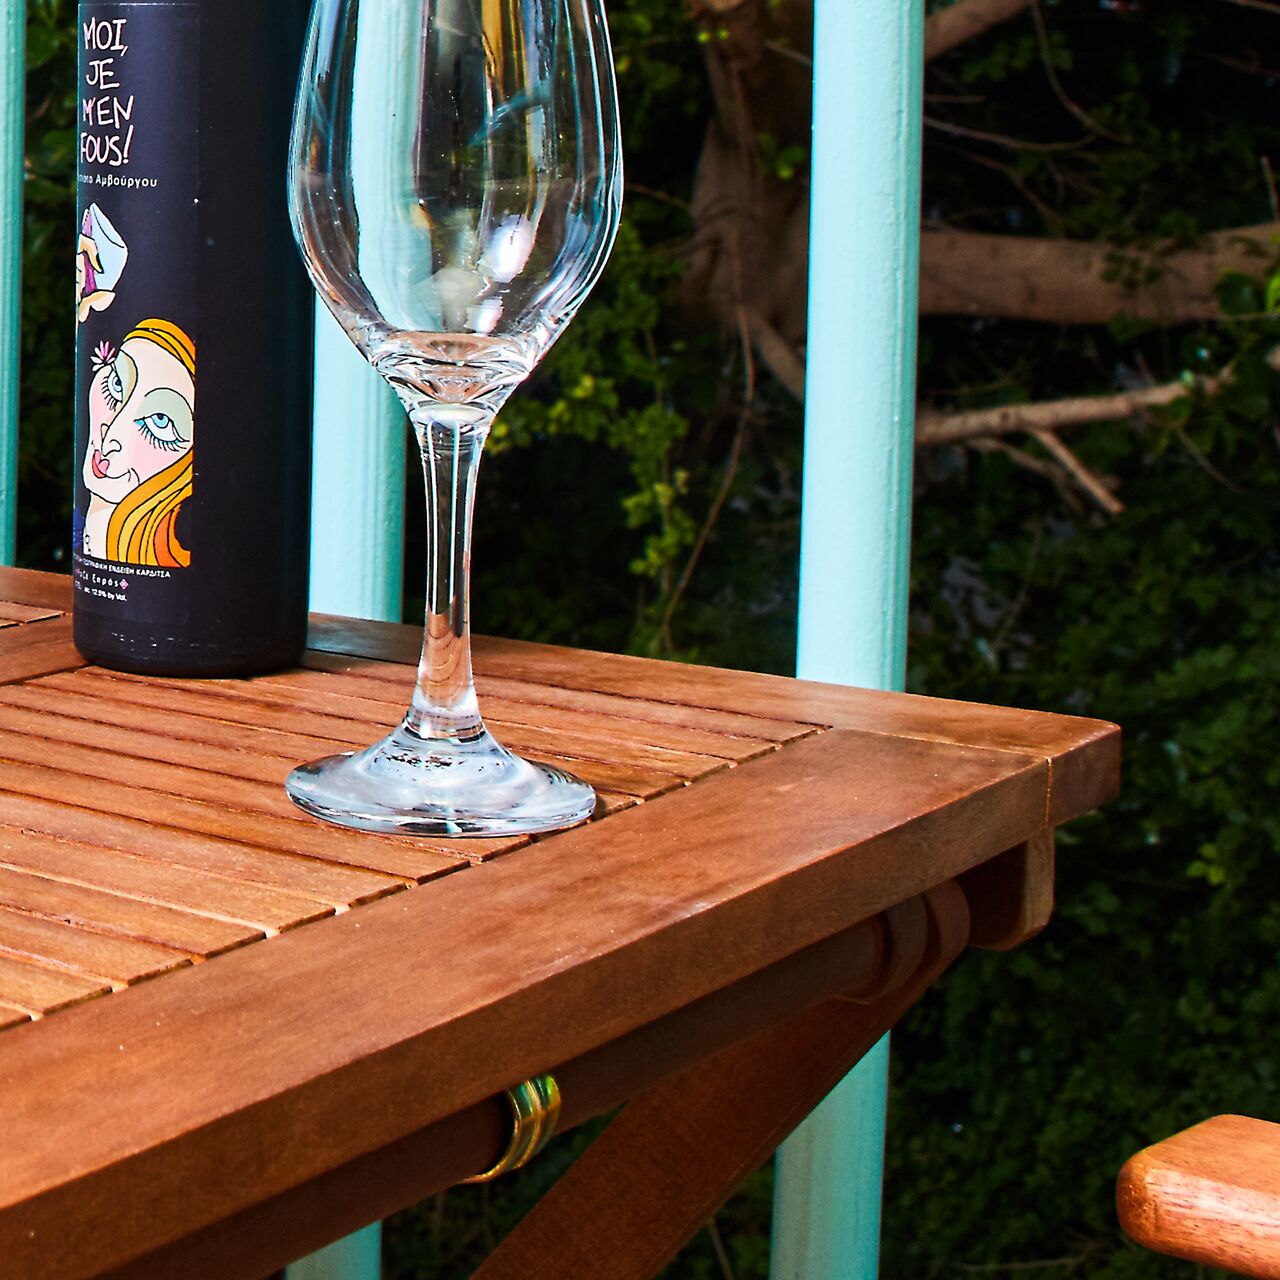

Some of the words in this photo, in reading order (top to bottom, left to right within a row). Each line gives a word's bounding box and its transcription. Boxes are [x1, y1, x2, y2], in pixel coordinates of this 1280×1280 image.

[83, 17, 128, 57] MOI,
[86, 58, 120, 90] JE
[80, 124, 134, 167] FOUS!
[95, 174, 158, 189] Αμβούργου
[136, 569, 171, 578] ΚΑΡΔΙΤΣΑ
